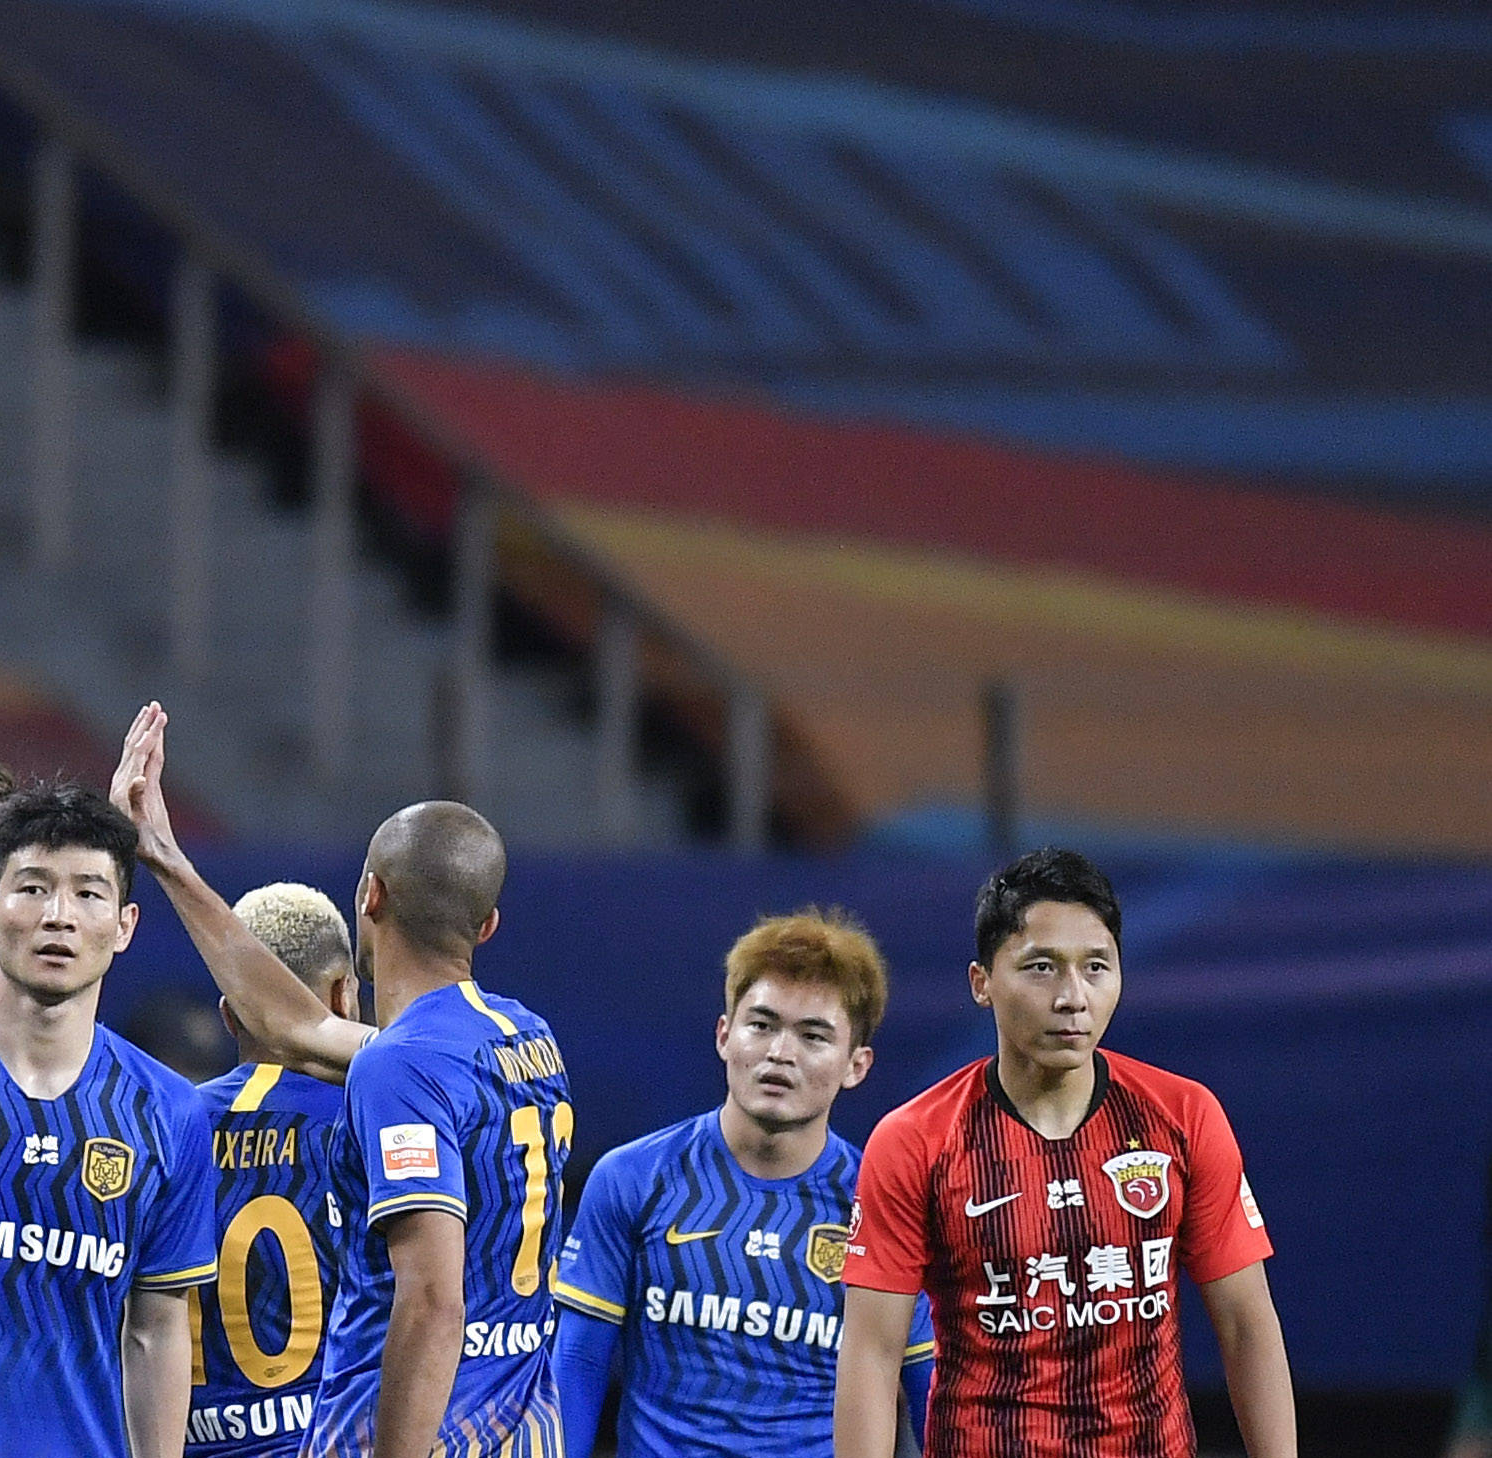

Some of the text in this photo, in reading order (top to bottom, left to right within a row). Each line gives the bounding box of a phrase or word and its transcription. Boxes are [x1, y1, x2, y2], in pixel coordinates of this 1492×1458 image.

[212, 1127, 296, 1170] IXEIRA
[975, 1236, 1174, 1305] 上汽集团
[645, 1285, 845, 1351] SAMSUN
[977, 1289, 1172, 1334] SAIC MOTOR
[185, 1393, 313, 1444] MSUN
